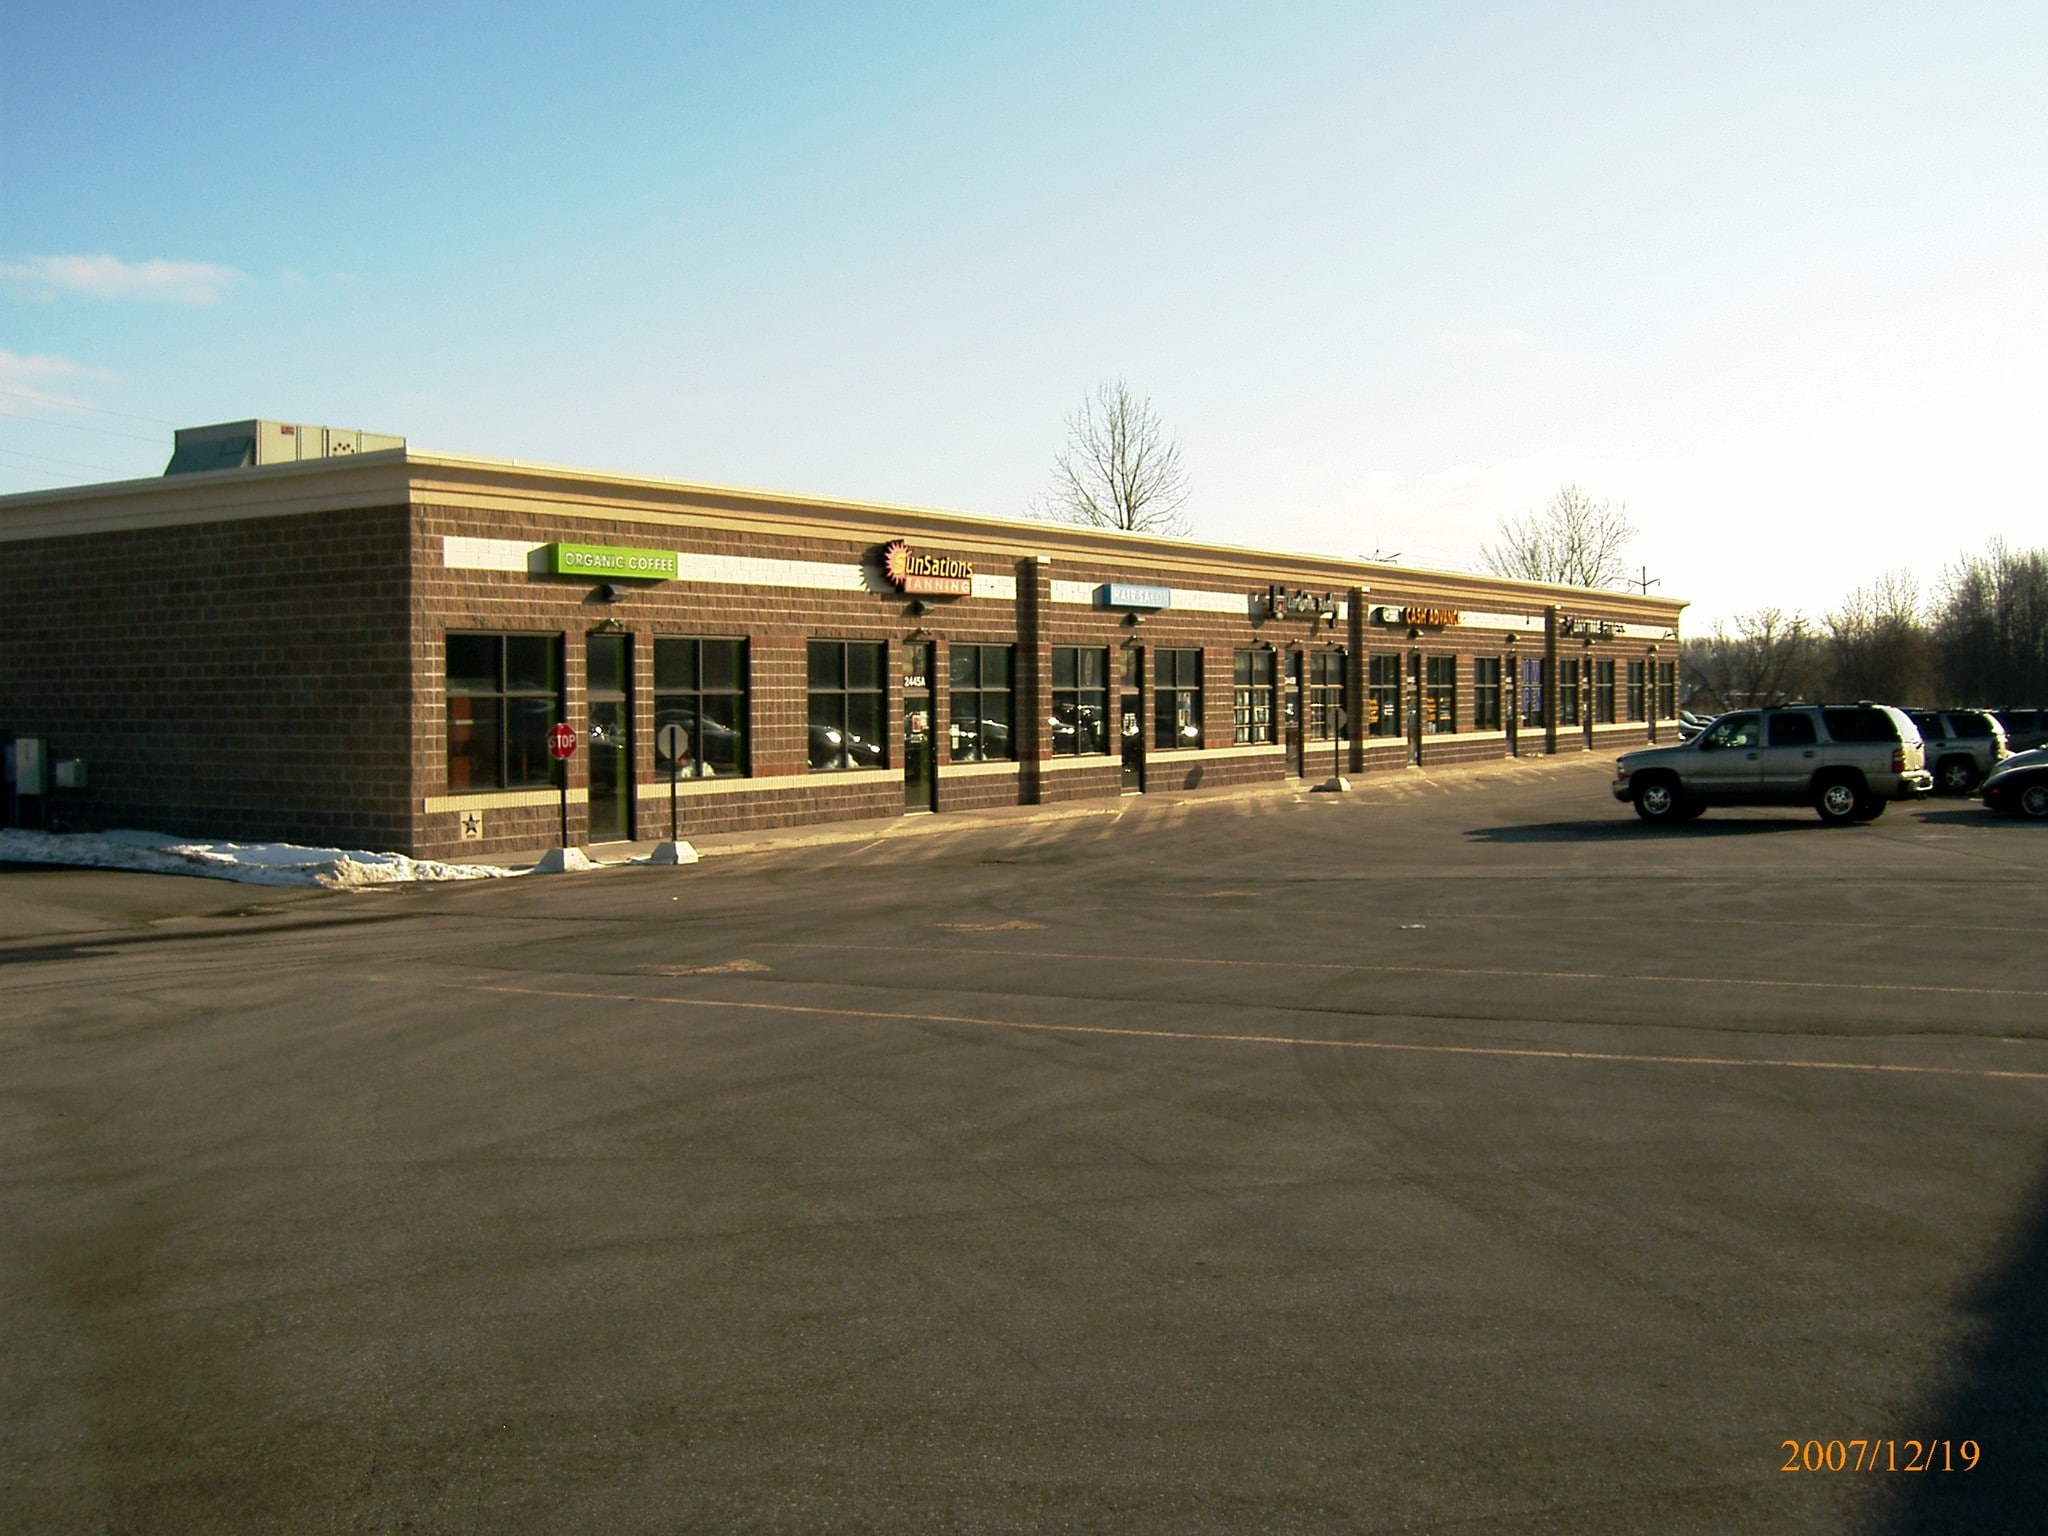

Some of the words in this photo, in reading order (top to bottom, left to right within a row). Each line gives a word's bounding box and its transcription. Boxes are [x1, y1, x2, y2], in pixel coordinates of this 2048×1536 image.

[565, 552, 624, 569] ORGANIC
[628, 556, 674, 572] COFFEE
[908, 577, 970, 592] TANNING
[1405, 607, 1427, 624] CASH
[904, 676, 926, 687] 2445A
[549, 734, 576, 749] STOP
